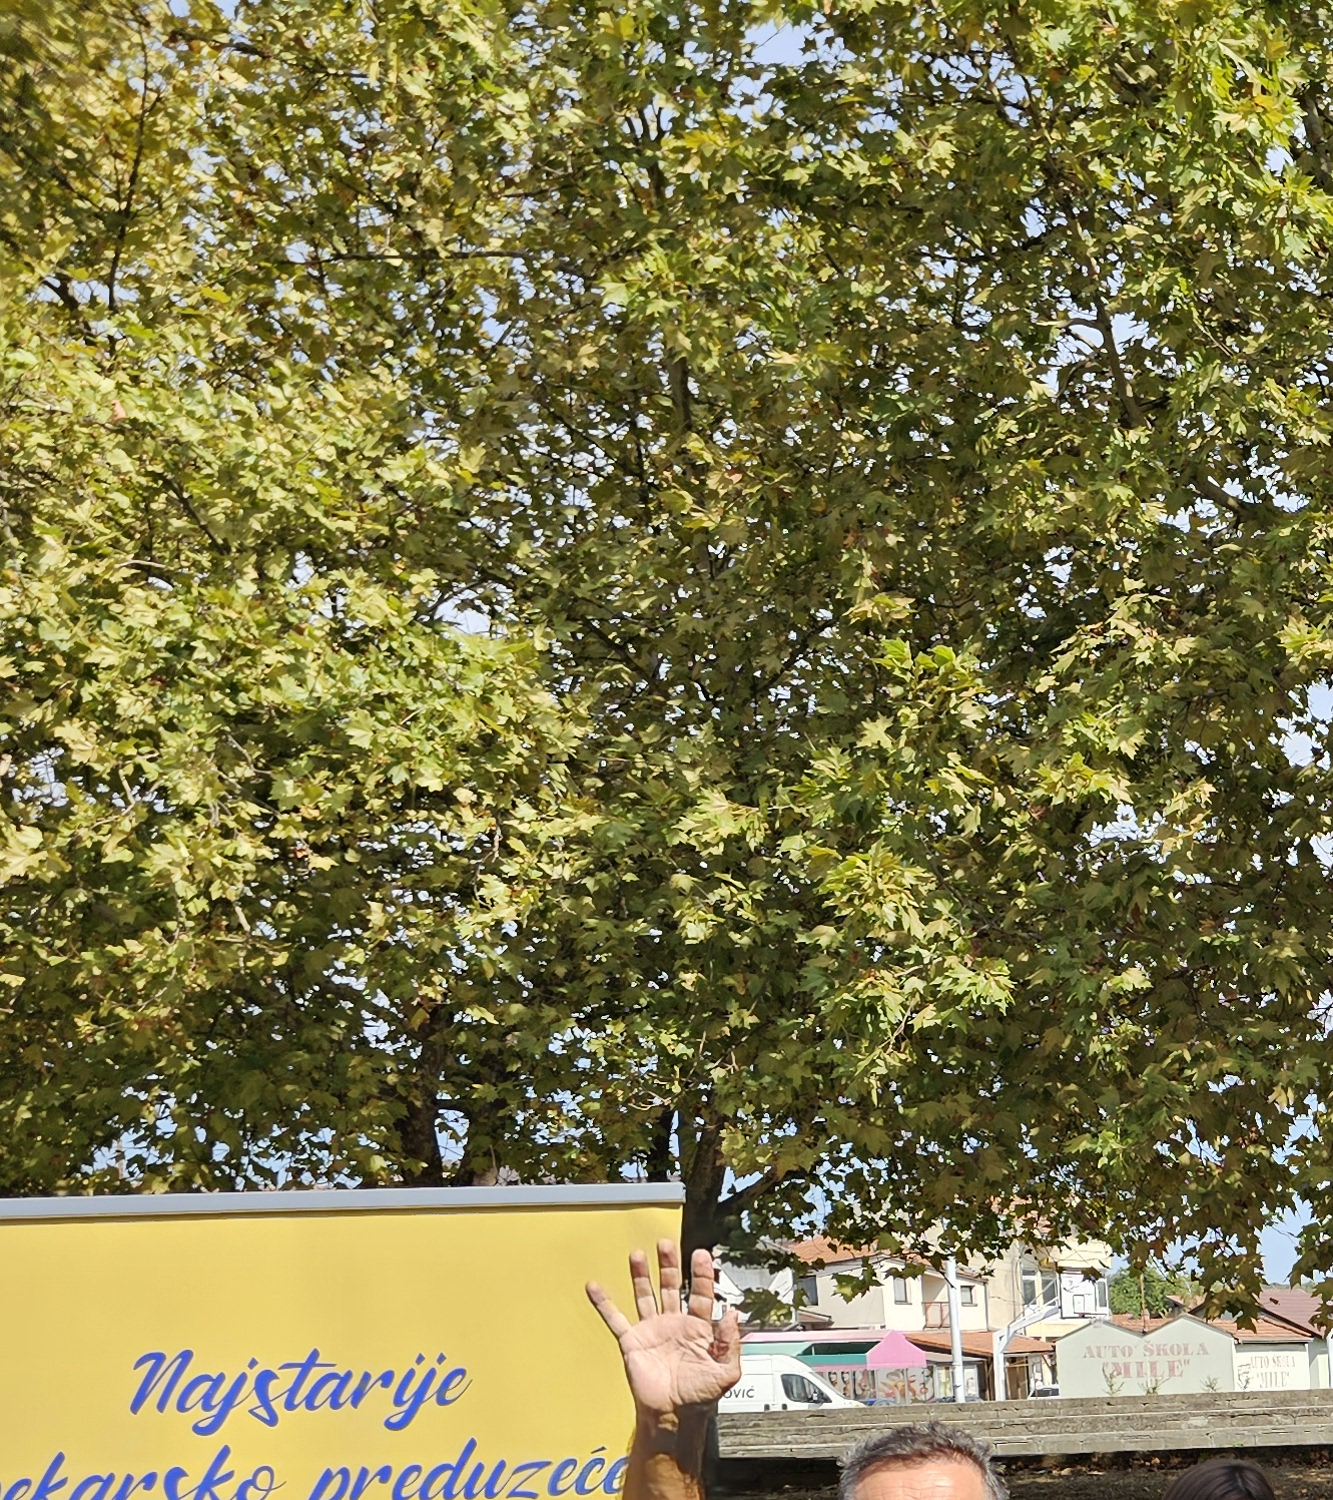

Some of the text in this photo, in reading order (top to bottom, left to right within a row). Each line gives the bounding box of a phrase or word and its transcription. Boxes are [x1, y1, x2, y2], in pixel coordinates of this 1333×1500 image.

[1082, 1339, 1210, 1360] AUTO ŠKOLA
[129, 1348, 473, 1437] Najstarije
[722, 1385, 756, 1399] OVIĆ
